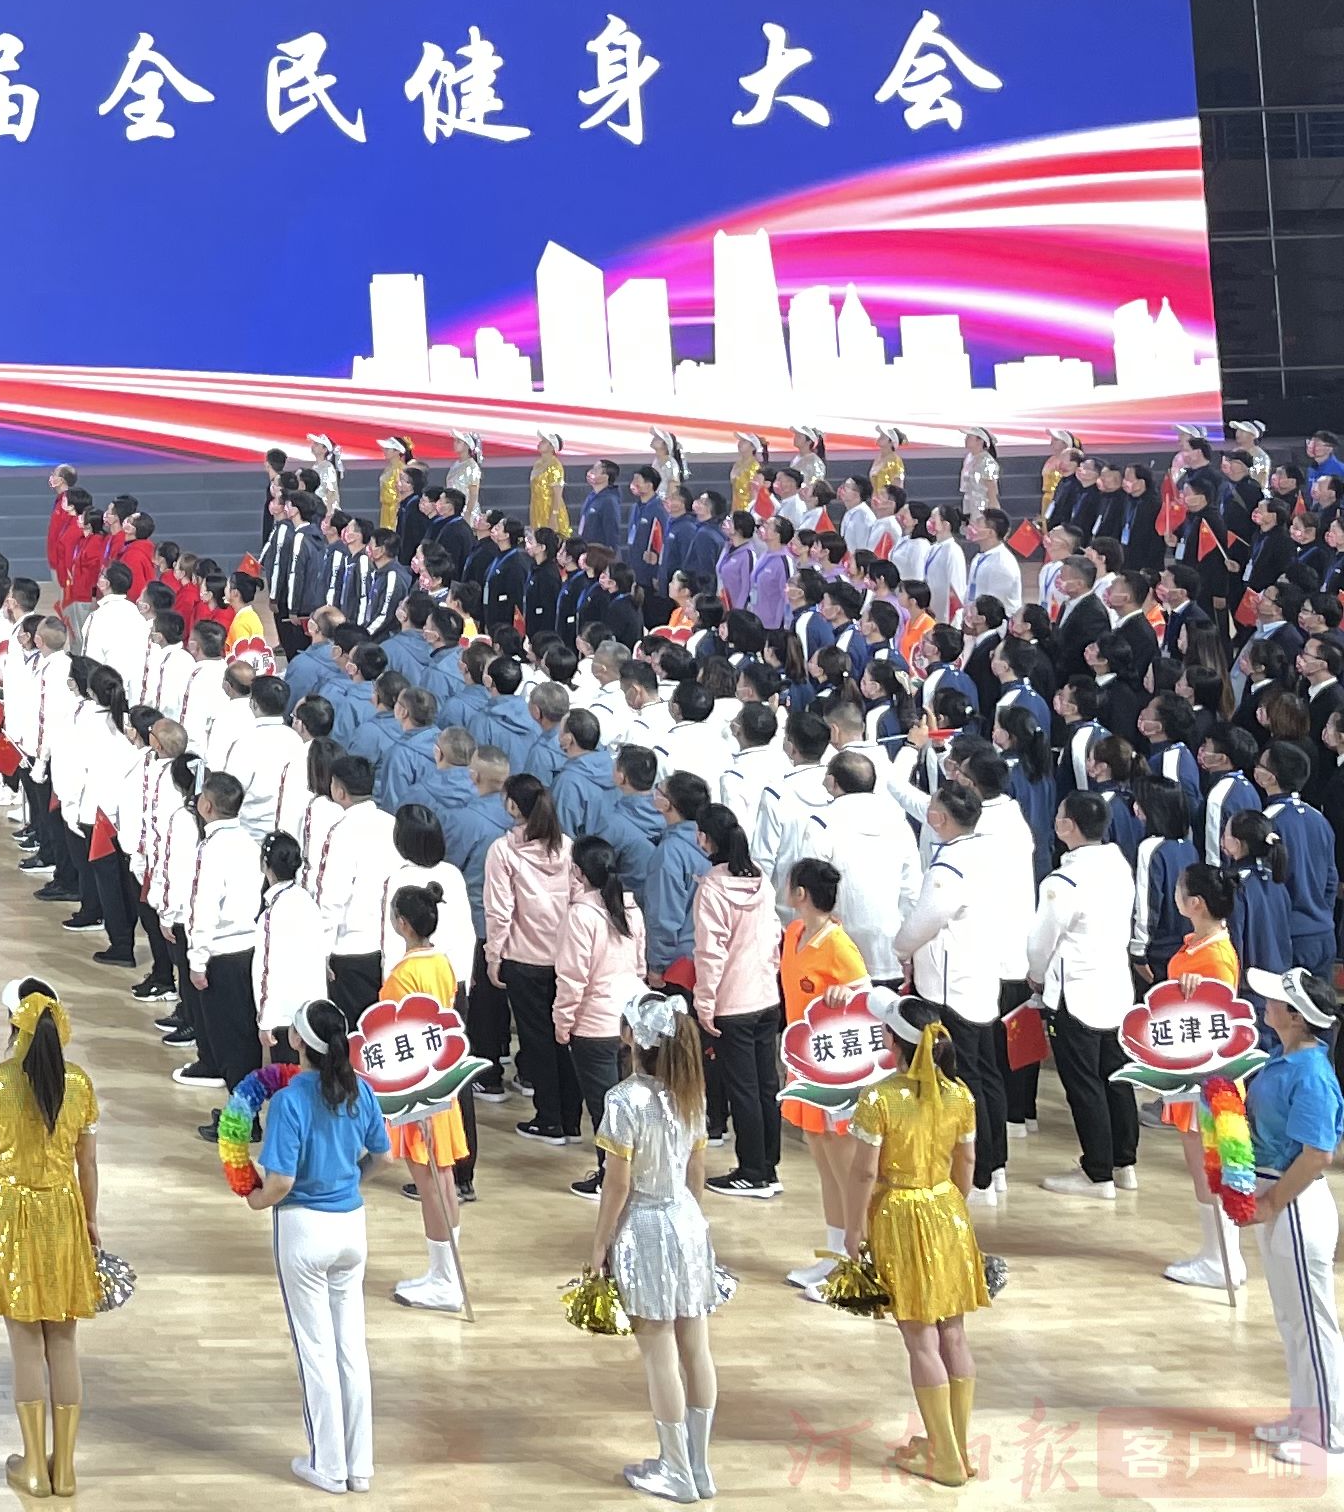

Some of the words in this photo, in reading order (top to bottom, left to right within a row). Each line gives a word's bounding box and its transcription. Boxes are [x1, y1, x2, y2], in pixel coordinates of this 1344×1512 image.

[362, 1026, 442, 1071] 辉县市
[812, 1025, 886, 1062] 获嘉县
[1150, 1014, 1230, 1047] 延津县
